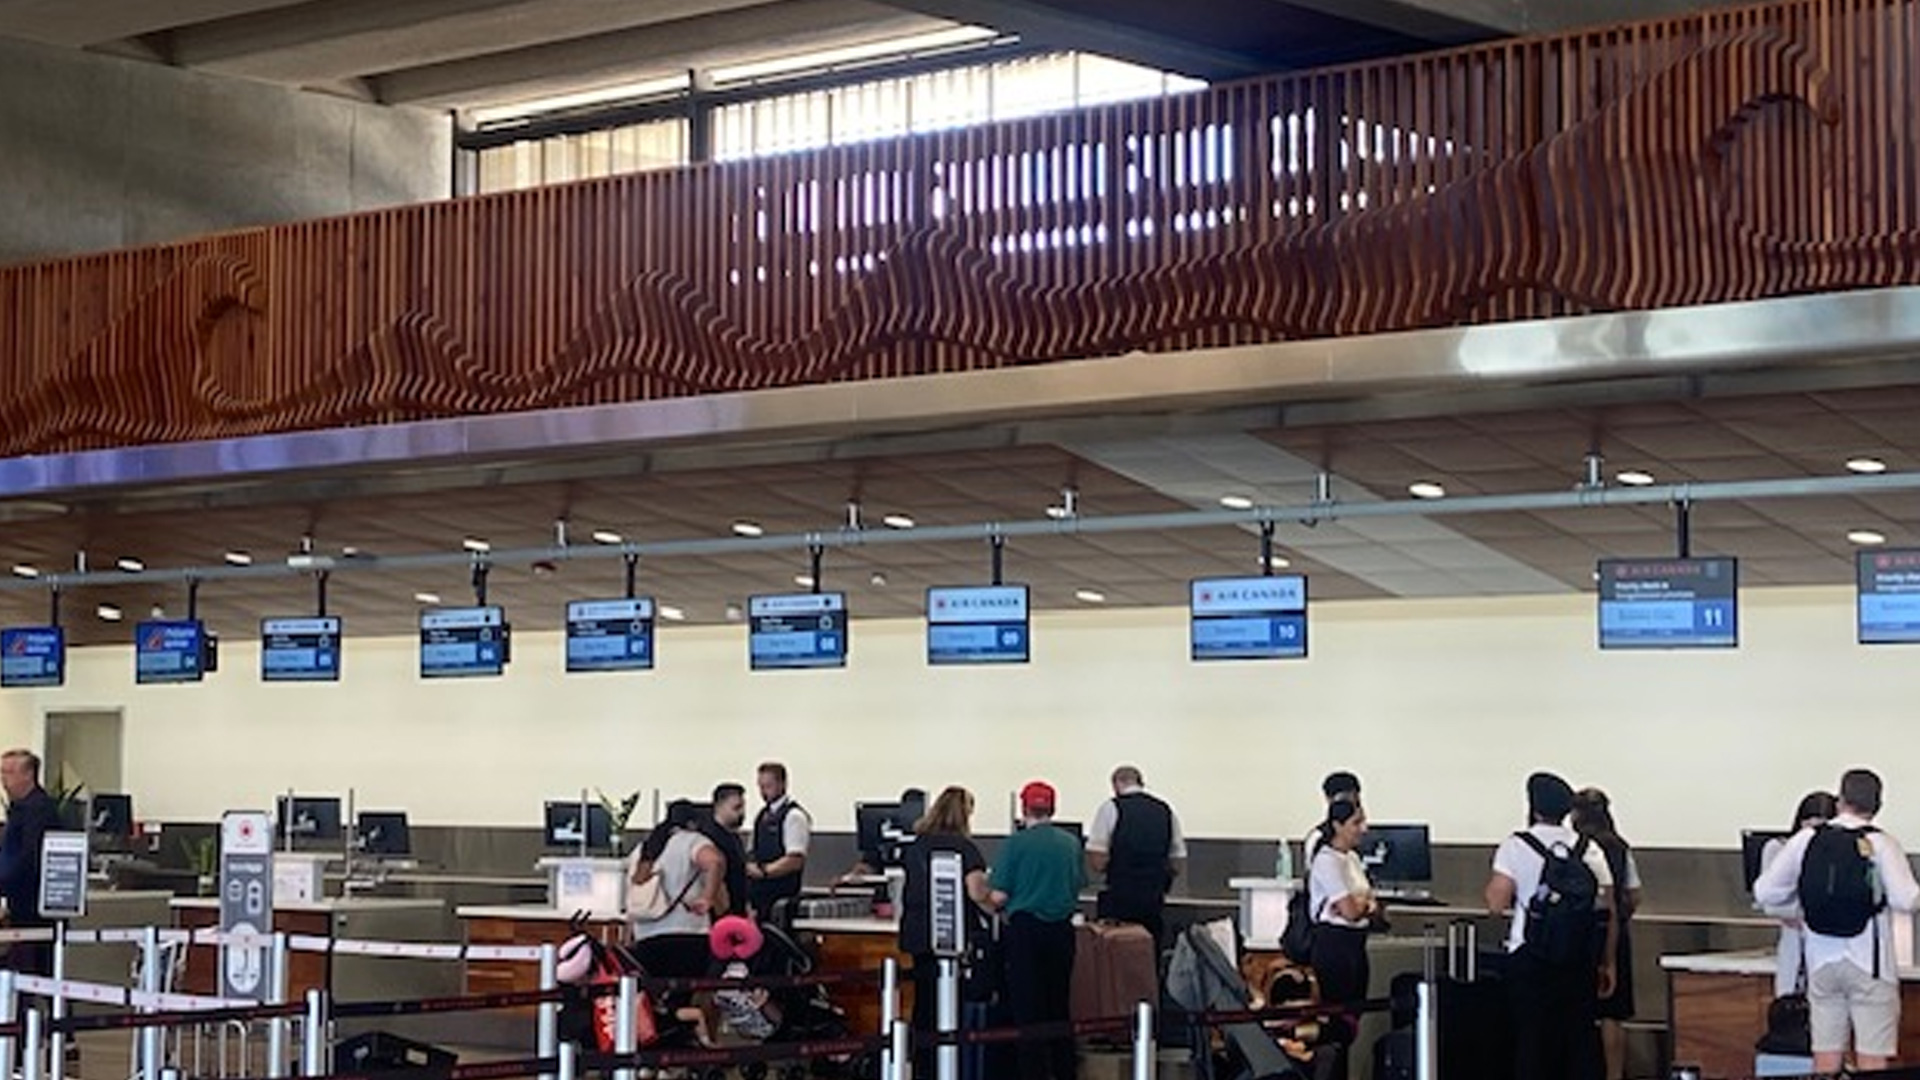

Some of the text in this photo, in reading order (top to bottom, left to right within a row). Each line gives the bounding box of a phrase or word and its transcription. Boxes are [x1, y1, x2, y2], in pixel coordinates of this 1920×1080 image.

[1241, 587, 1297, 601] CANADA
[1704, 608, 1722, 627] 11
[1279, 624, 1297, 640] 10
